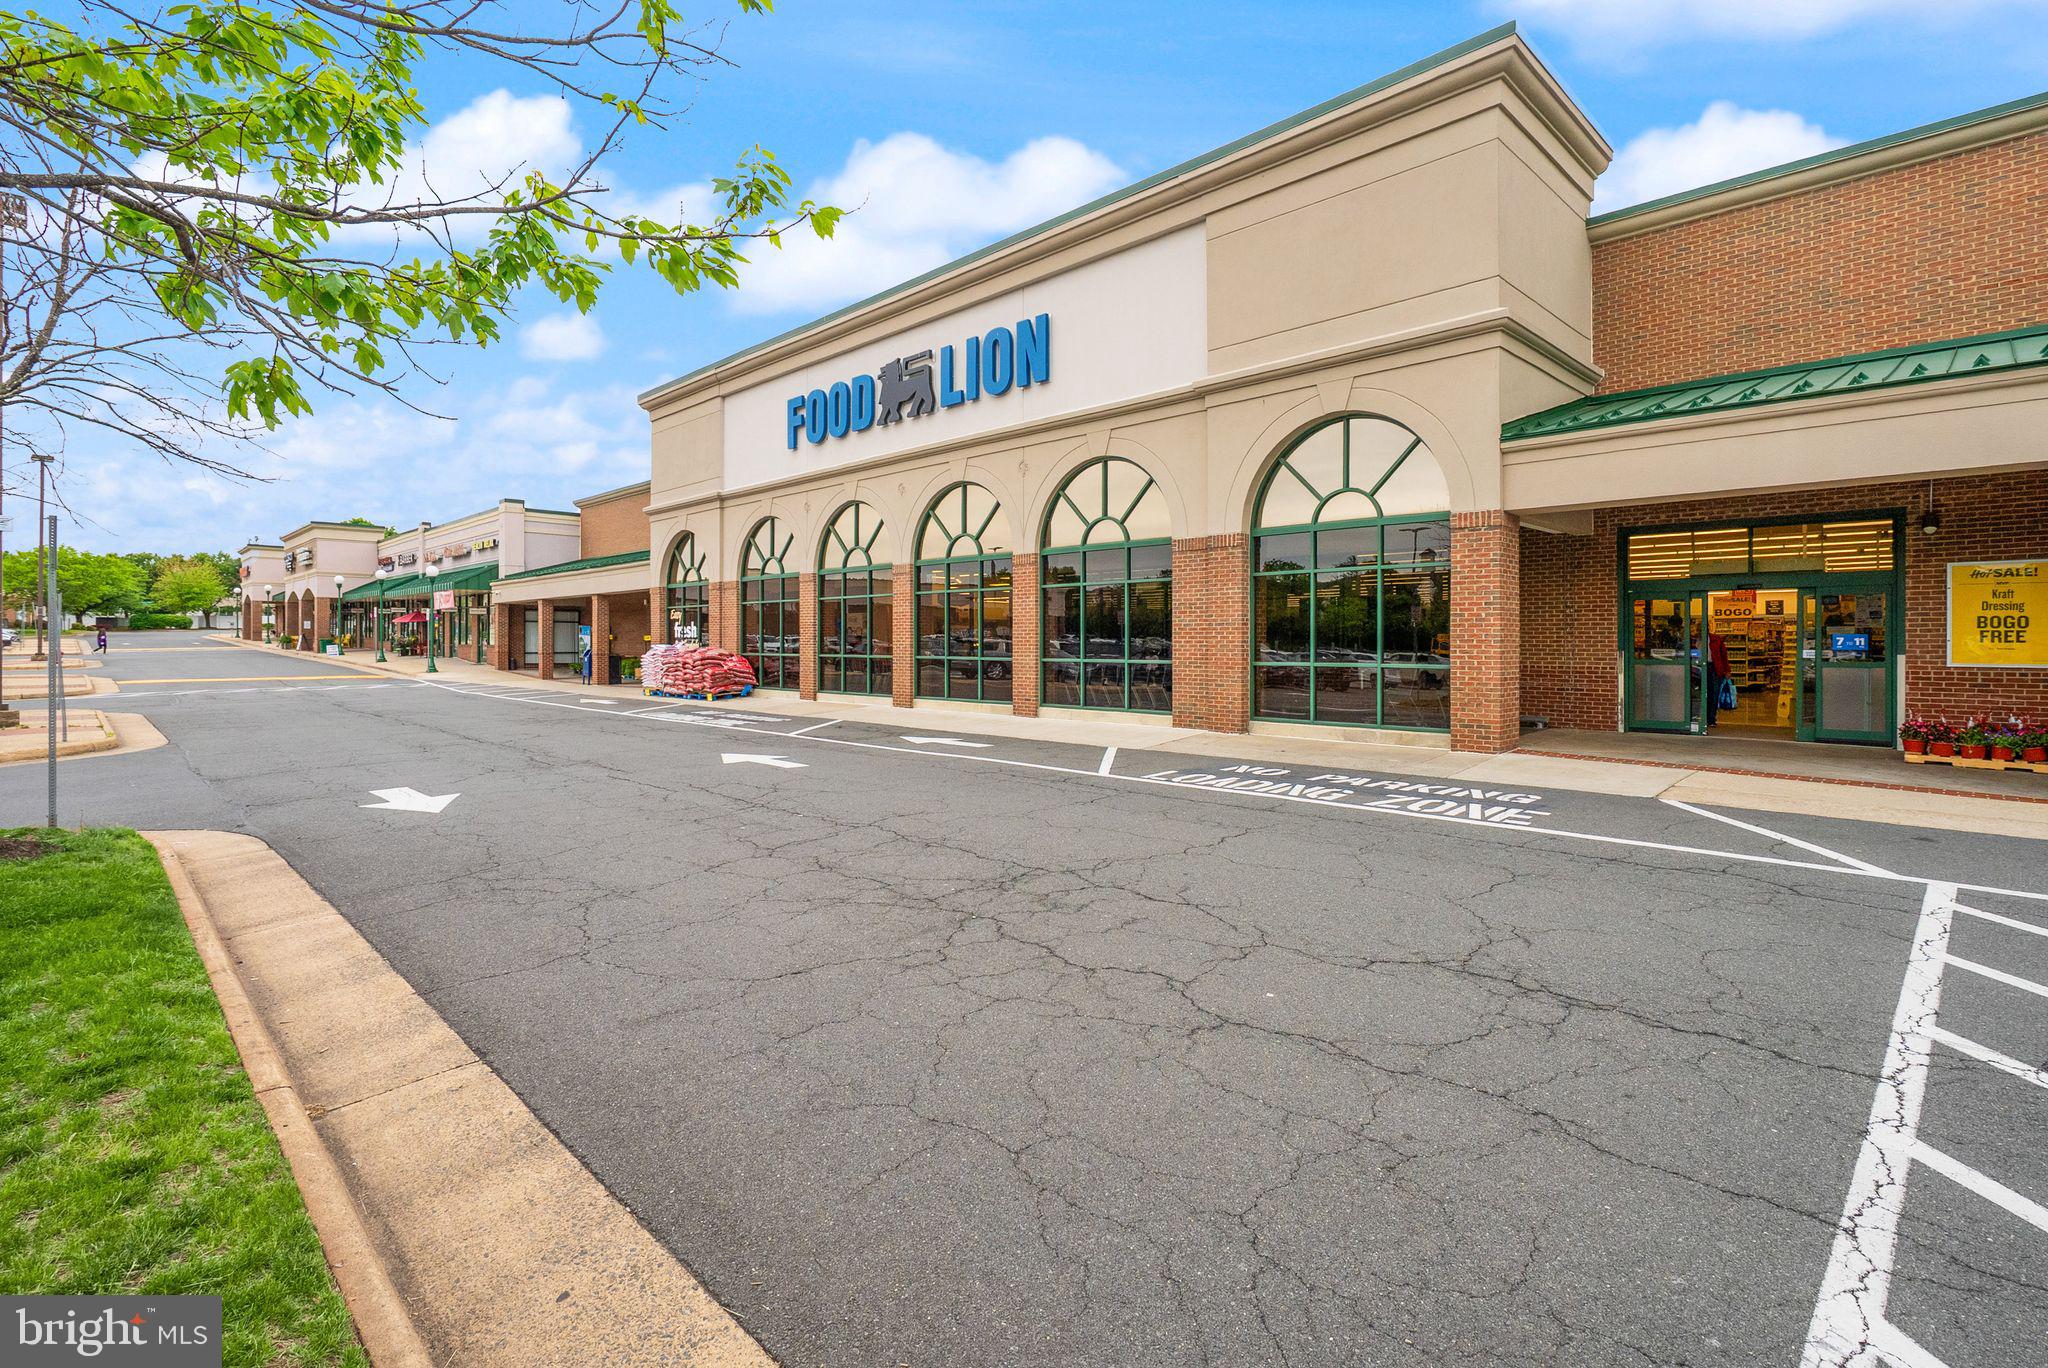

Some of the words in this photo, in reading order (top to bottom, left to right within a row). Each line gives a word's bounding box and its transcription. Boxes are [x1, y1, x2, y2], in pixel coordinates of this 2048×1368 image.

[787, 374, 876, 450] FOOD
[940, 313, 1050, 409] LION
[1993, 567, 2039, 577] SALE!
[1992, 589, 2014, 599] Kraft
[1715, 608, 1752, 616] BOGO
[1981, 601, 2025, 612] Dressing
[1976, 615, 2030, 629] BOGO
[1836, 637, 1844, 646] 7
[1854, 637, 1866, 646] 11
[1979, 630, 2026, 643] FREE
[1220, 764, 1291, 776] NO
[1306, 774, 1543, 804] PARKING
[1142, 770, 1355, 801] LOADING
[1364, 794, 1552, 826] ZONE
